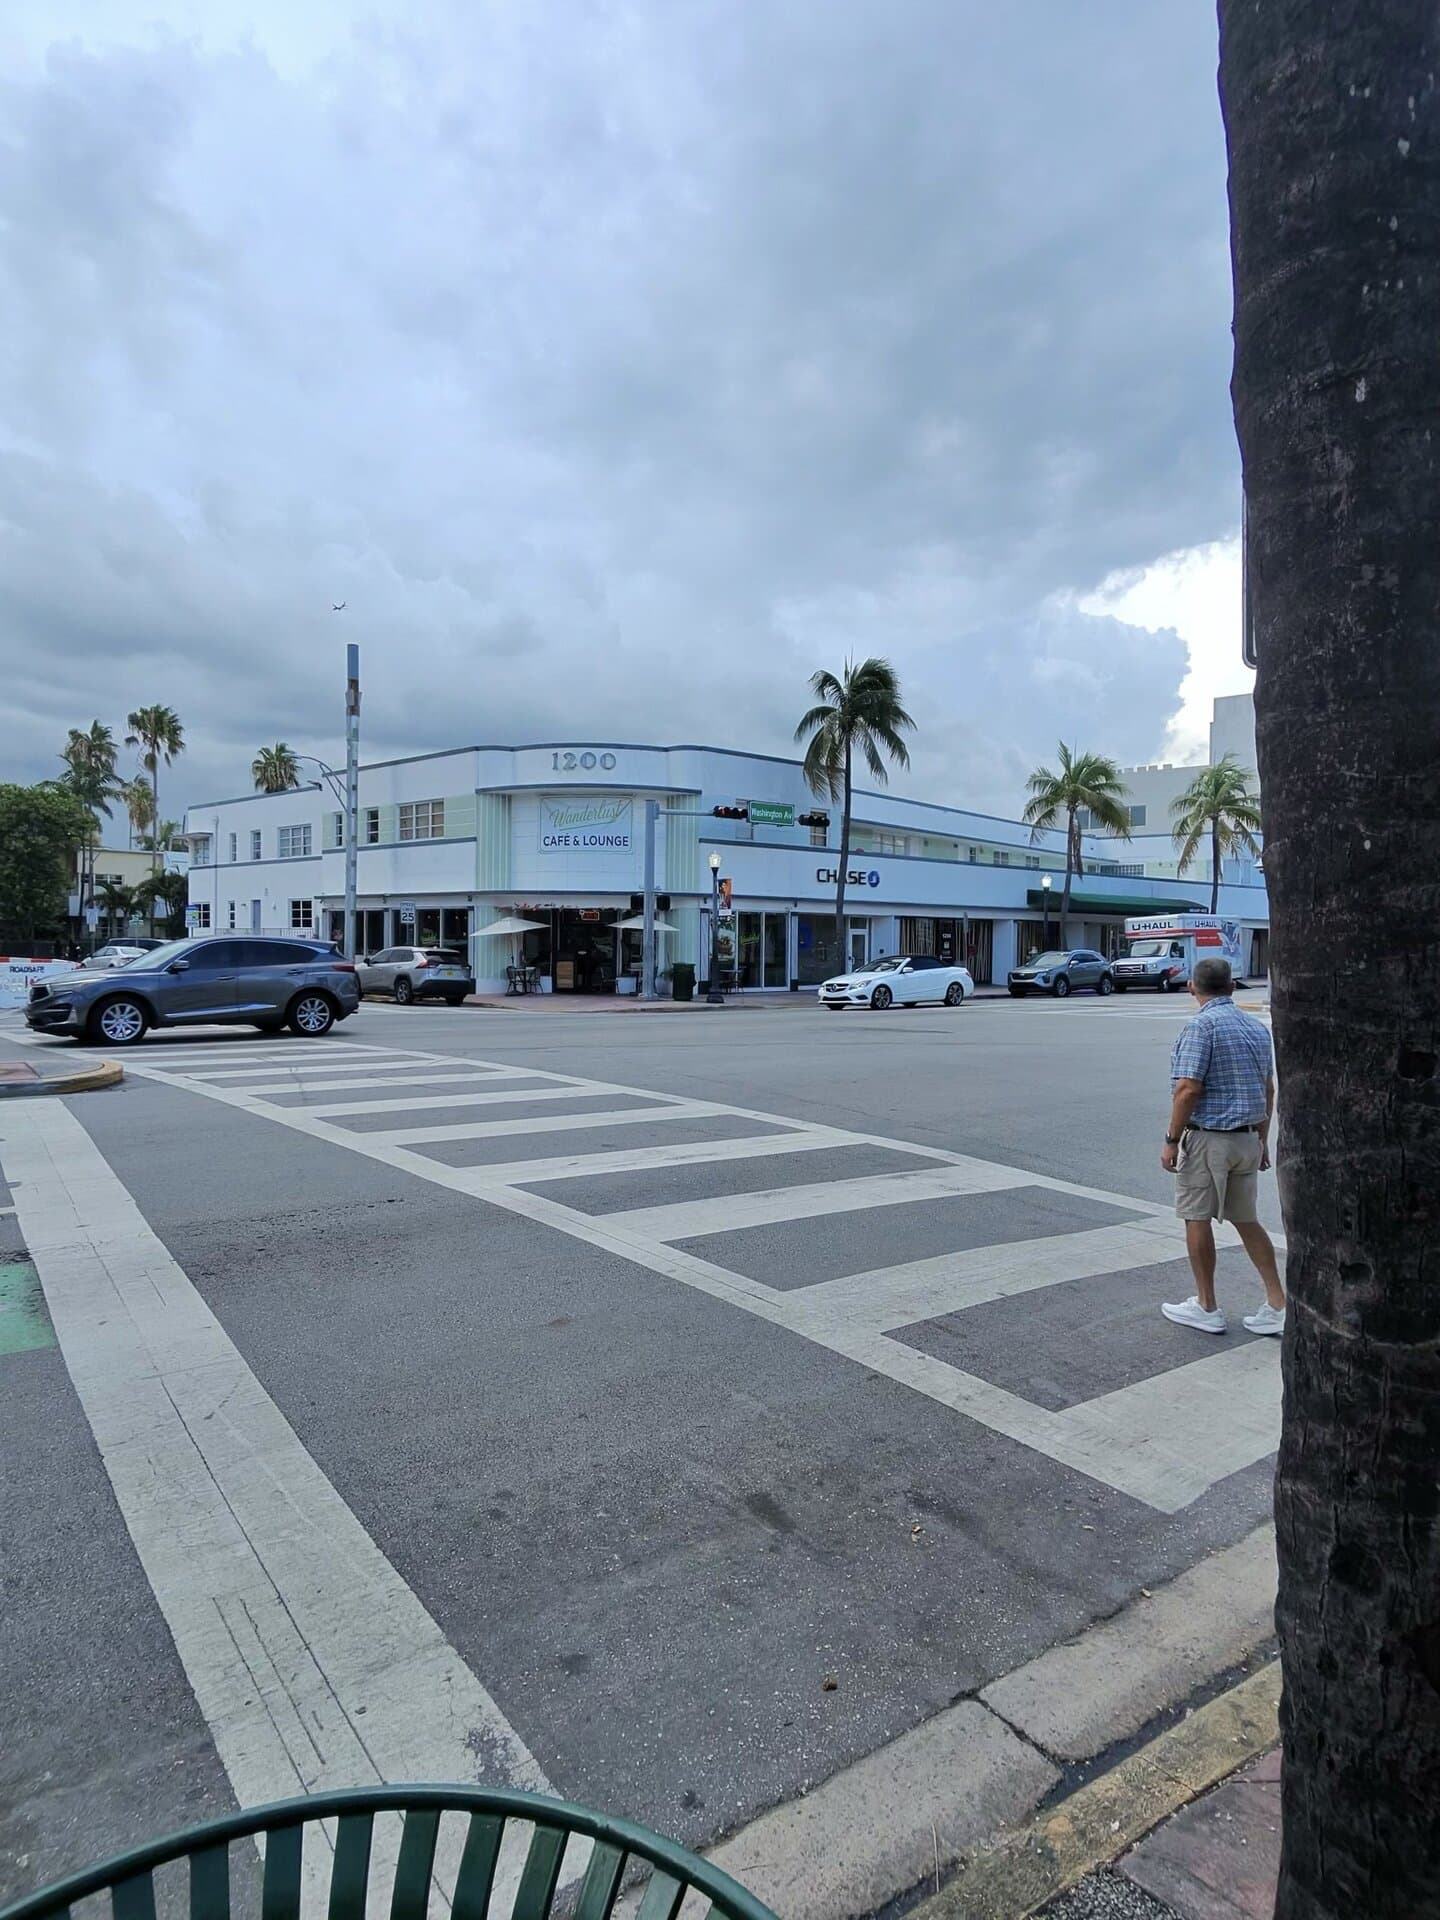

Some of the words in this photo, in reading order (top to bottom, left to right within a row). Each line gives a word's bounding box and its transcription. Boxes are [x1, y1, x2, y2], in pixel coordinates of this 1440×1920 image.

[552, 751, 617, 771] 1200
[549, 799, 623, 829] Wanderlust
[751, 807, 783, 820] Washington
[543, 833, 571, 847] CAFÉ
[573, 835, 580, 846] &
[583, 835, 629, 847] LOUNGE
[402, 912, 415, 922] 25
[1132, 921, 1174, 931] U-HAUL
[1194, 920, 1217, 928] U-HAUL
